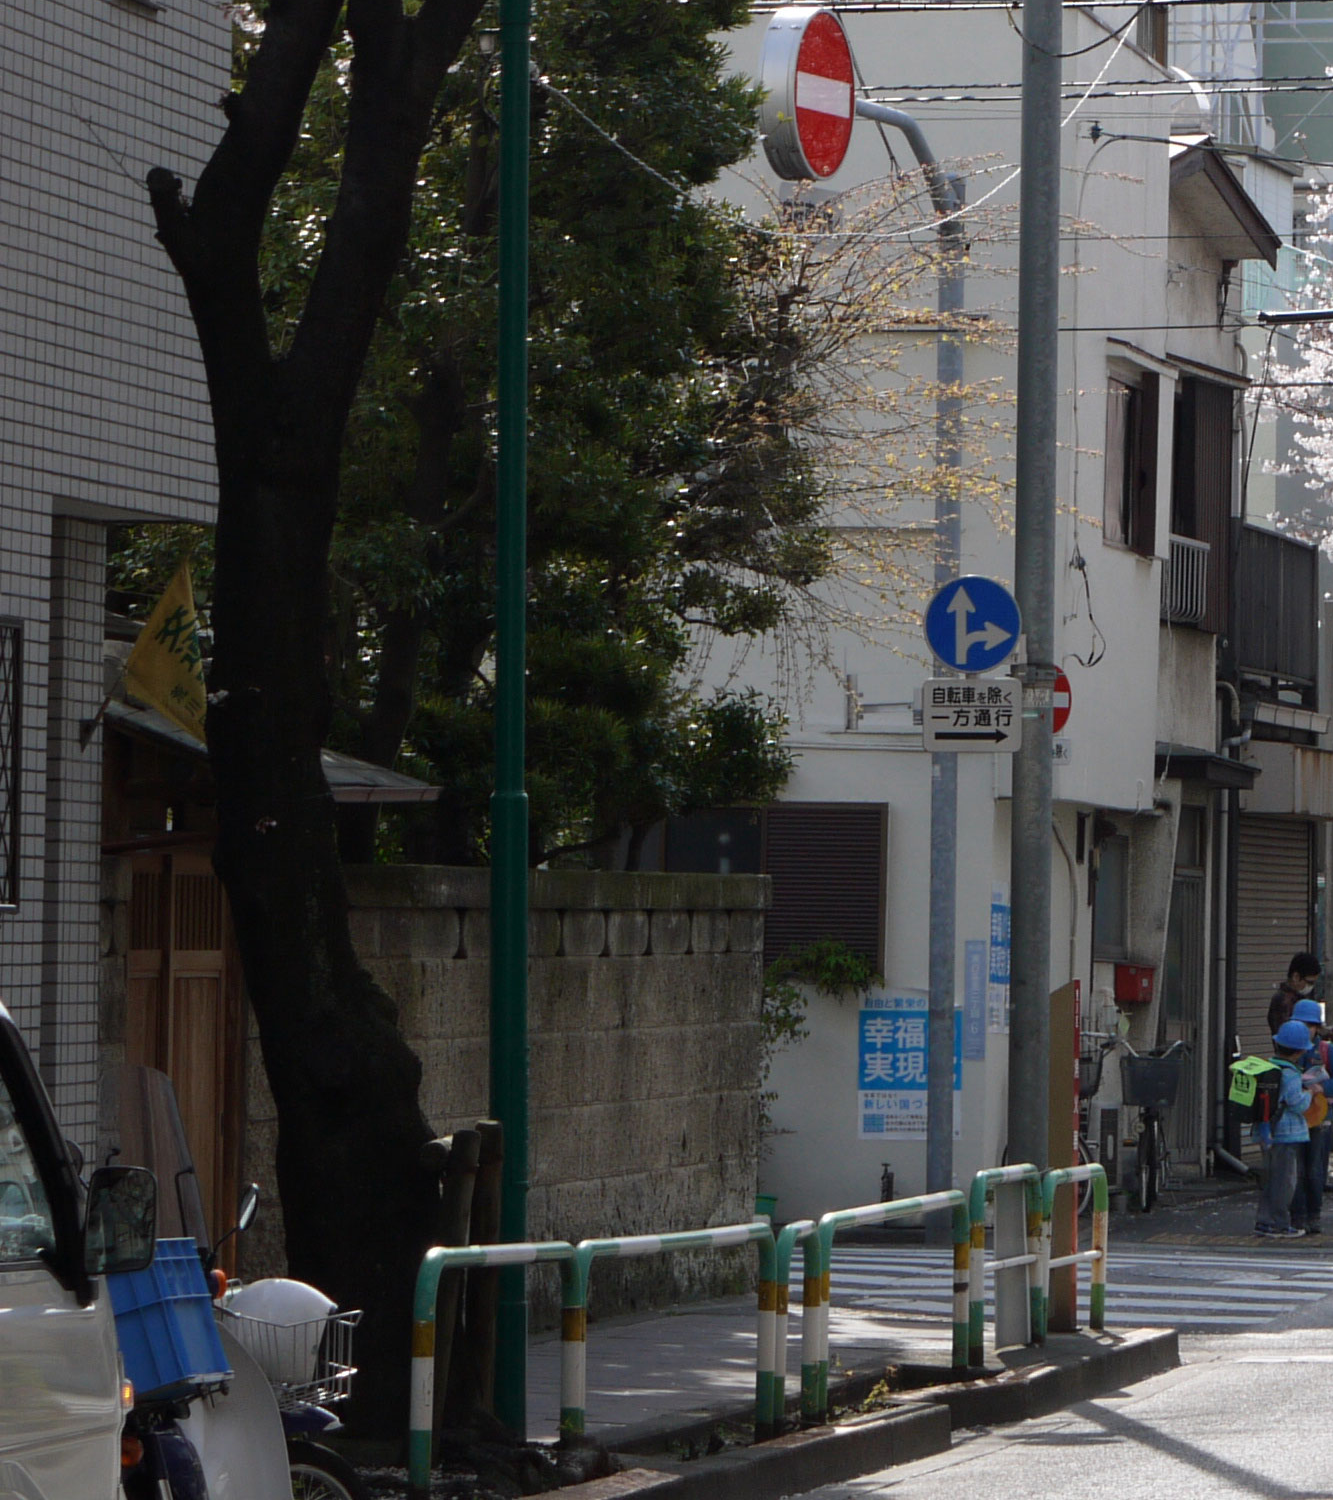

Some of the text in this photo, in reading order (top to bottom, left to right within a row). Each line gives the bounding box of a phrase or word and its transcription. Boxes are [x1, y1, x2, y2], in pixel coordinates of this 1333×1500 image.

[932, 686, 1013, 705] 自転車を除く
[931, 709, 1013, 727] 一方通行
